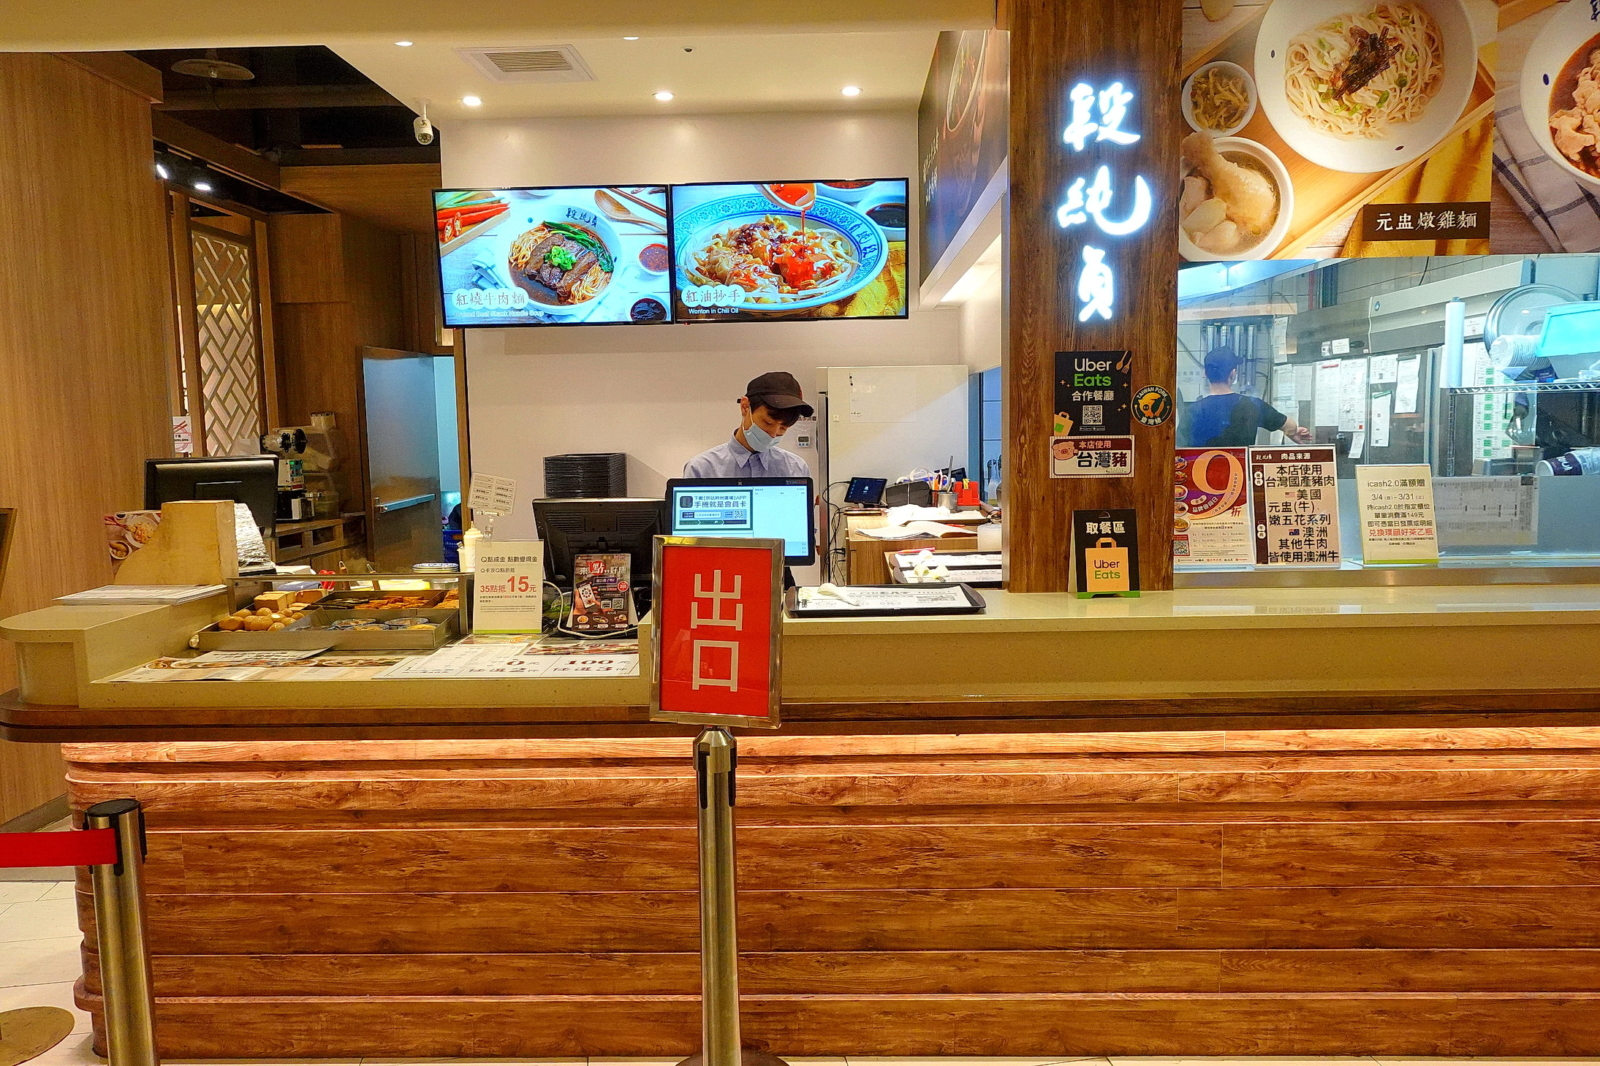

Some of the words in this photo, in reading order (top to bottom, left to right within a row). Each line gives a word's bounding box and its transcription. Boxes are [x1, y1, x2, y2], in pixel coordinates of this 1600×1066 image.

[1375, 210, 1477, 231] 元盅燉雞麵
[456, 291, 525, 306] 紅燒牛肉麵
[686, 289, 741, 303] 紅油抄手
[1074, 358, 1112, 372] Uber
[1074, 373, 1112, 387] Eats
[1071, 390, 1115, 402] 合作餐廳
[1137, 386, 1155, 398] TAIWAN
[1155, 387, 1168, 398] PORK
[1078, 440, 1112, 449] 本店使用
[1077, 451, 1128, 468] 台灣豬
[1280, 452, 1311, 460] 肉品來源
[1276, 464, 1323, 476] 本店使用
[1185, 450, 1244, 520] 9
[1265, 475, 1335, 488] 台灣國產豬肉
[1296, 489, 1322, 500] 美國
[694, 500, 747, 508] 手機就是會員卡
[1231, 506, 1242, 517] 折
[1269, 513, 1331, 526] 嫩五花系列
[1085, 520, 1126, 534] 取餐區
[1302, 526, 1328, 538] 澳洲
[1278, 538, 1328, 550] 其他牛肉
[1268, 550, 1339, 563] 皆使用澳洲牛
[1093, 559, 1120, 569] Uber
[1094, 570, 1121, 579] Eats
[690, 569, 743, 692] 出口
